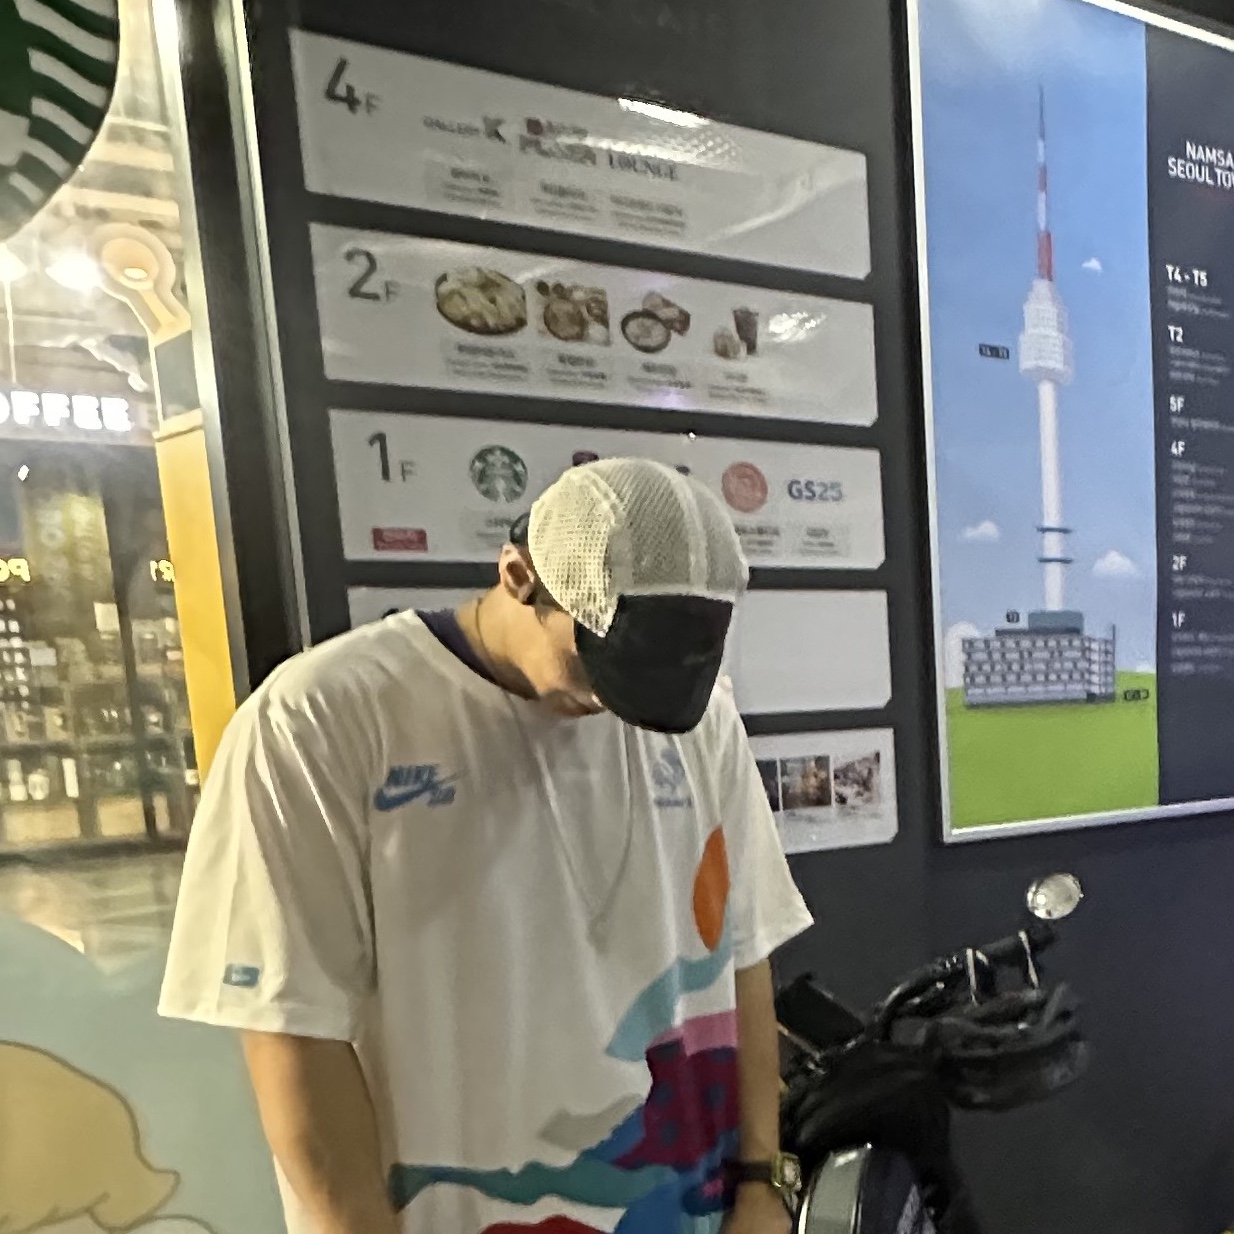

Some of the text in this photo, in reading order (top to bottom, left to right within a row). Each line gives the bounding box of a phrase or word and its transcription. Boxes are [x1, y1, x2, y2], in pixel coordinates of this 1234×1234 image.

[1167, 155, 1215, 187] SEOUL
[1165, 263, 1183, 283] T4
[1167, 323, 1184, 343] T2
[787, 479, 844, 502] GS25
[1171, 554, 1187, 571] 2F
[1171, 611, 1186, 629] 1F
